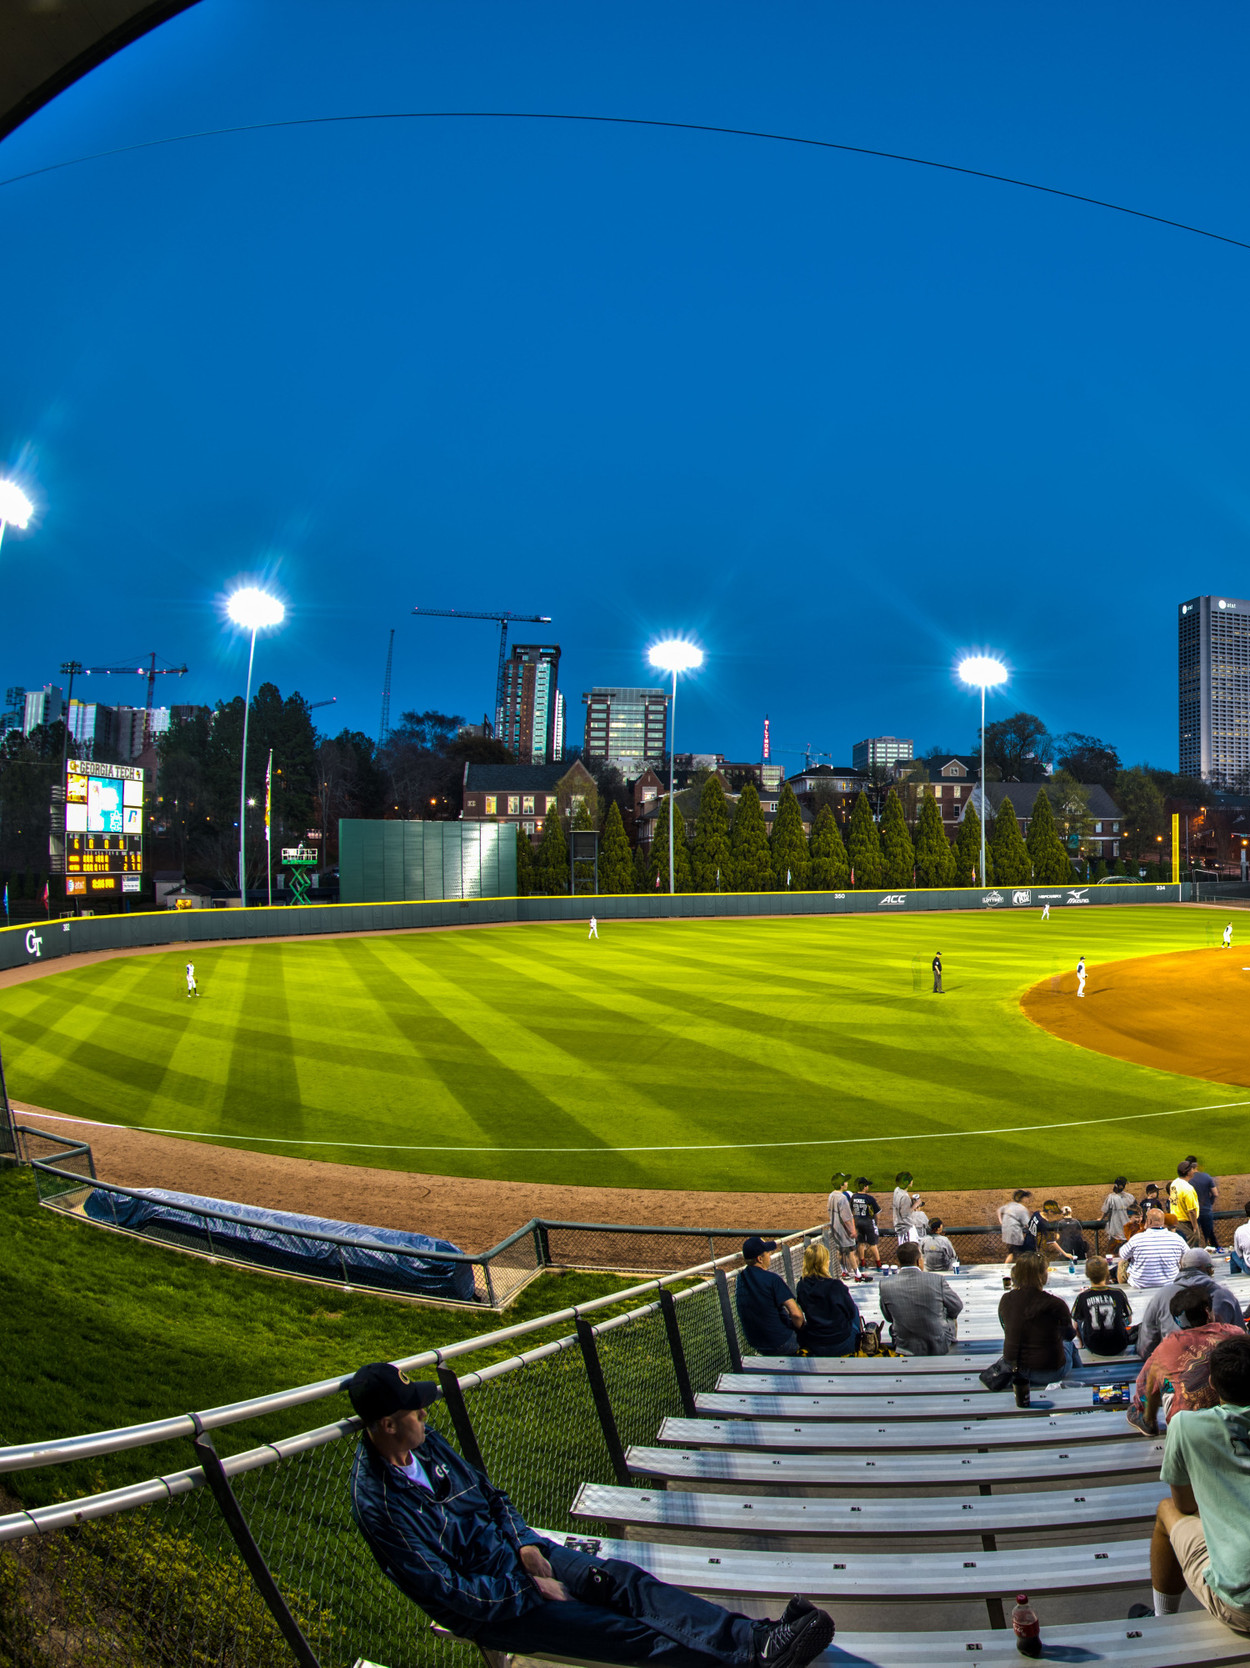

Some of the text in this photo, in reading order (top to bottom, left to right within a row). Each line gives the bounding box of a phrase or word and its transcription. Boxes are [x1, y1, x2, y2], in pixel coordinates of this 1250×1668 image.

[80, 761, 135, 779] GEORGIA TECH
[880, 894, 907, 904] ACC
[26, 928, 43, 957] GT
[1089, 1305, 1115, 1330] 17
